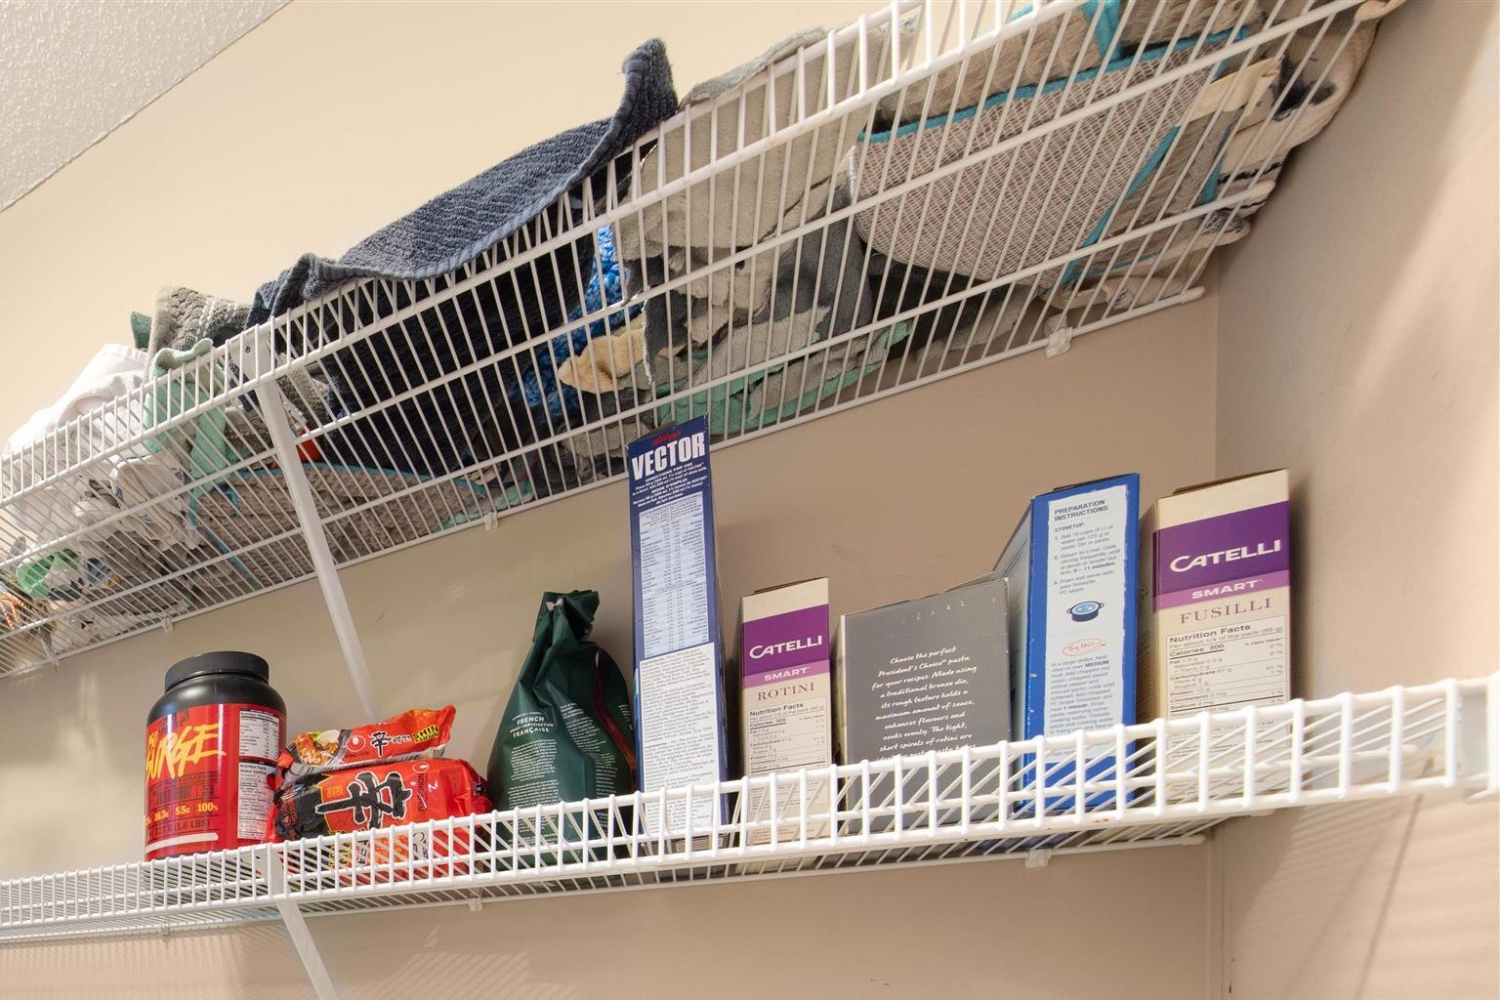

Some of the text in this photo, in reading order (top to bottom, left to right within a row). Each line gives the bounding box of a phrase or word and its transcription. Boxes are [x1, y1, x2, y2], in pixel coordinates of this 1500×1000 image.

[631, 432, 705, 480] VECTOR
[1054, 499, 1105, 515] PREPARATION
[1054, 505, 1109, 521] INSTRUCTIONS
[1169, 539, 1281, 572] CATELLI
[1192, 580, 1260, 599] SMART
[1180, 598, 1271, 624] FUSILLI
[1170, 624, 1250, 643] Nutrition Facts
[749, 635, 822, 659] CATELLI
[890, 656, 914, 664] Choose
[928, 646, 956, 658] perfect
[1170, 648, 1204, 656] Calories
[764, 667, 810, 681] SMART
[878, 665, 917, 677] President's
[947, 655, 970, 665] pasta
[872, 682, 884, 691] for
[885, 680, 902, 688] your
[931, 669, 954, 678] Made
[955, 666, 977, 674] using
[758, 682, 814, 700] ROTINI
[886, 685, 928, 697] traditional
[929, 681, 953, 690] bronze
[892, 698, 912, 707] rough
[914, 695, 940, 703] texture
[941, 689, 961, 698] holds
[517, 716, 544, 725] FRENCH
[750, 707, 781, 716] Nutrition
[875, 711, 911, 721] maximum
[912, 704, 940, 714] amount
[941, 702, 951, 710] of
[885, 711, 966, 730] enhances flavours and
[371, 731, 393, 757] 辛
[880, 743, 899, 752] short
[900, 739, 924, 748] spirals
[925, 737, 935, 746] of
[936, 735, 958, 743] rotini
[883, 732, 902, 740] cooks
